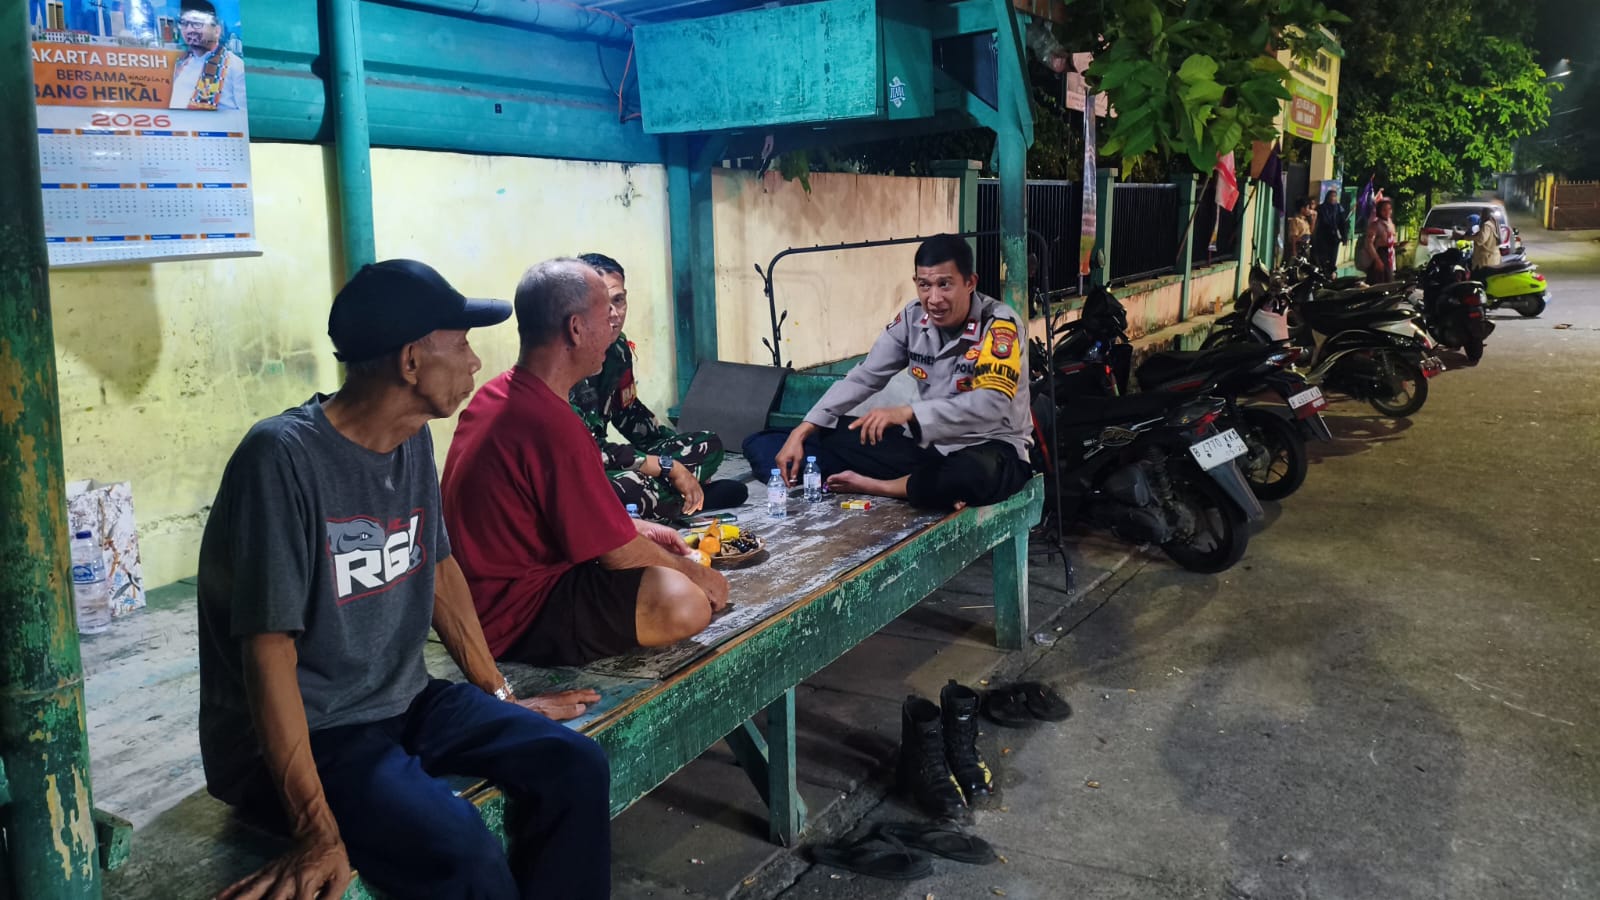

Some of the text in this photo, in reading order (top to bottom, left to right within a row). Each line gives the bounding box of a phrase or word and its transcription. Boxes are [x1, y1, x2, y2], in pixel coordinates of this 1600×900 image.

[31, 49, 168, 68] AKARTA BERSIH
[56, 69, 128, 83] BERSAMA
[92, 85, 162, 102] HEIKAL
[91, 113, 171, 128] 2026
